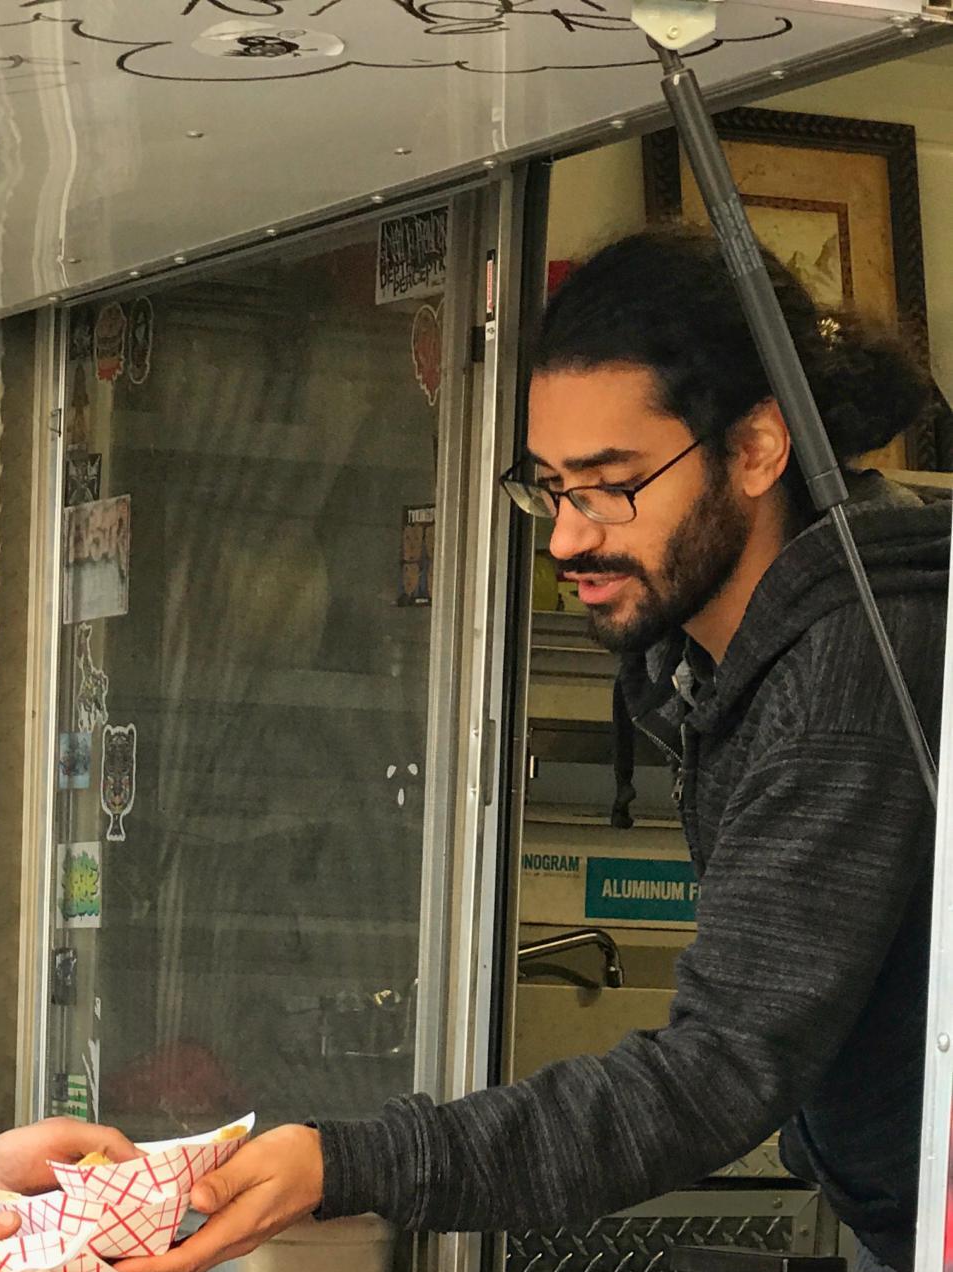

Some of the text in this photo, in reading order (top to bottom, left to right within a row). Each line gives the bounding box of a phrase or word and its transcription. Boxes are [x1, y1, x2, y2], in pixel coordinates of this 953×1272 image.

[521, 853, 580, 872] NOGRAM
[602, 878, 702, 902] ALUMINUM F
